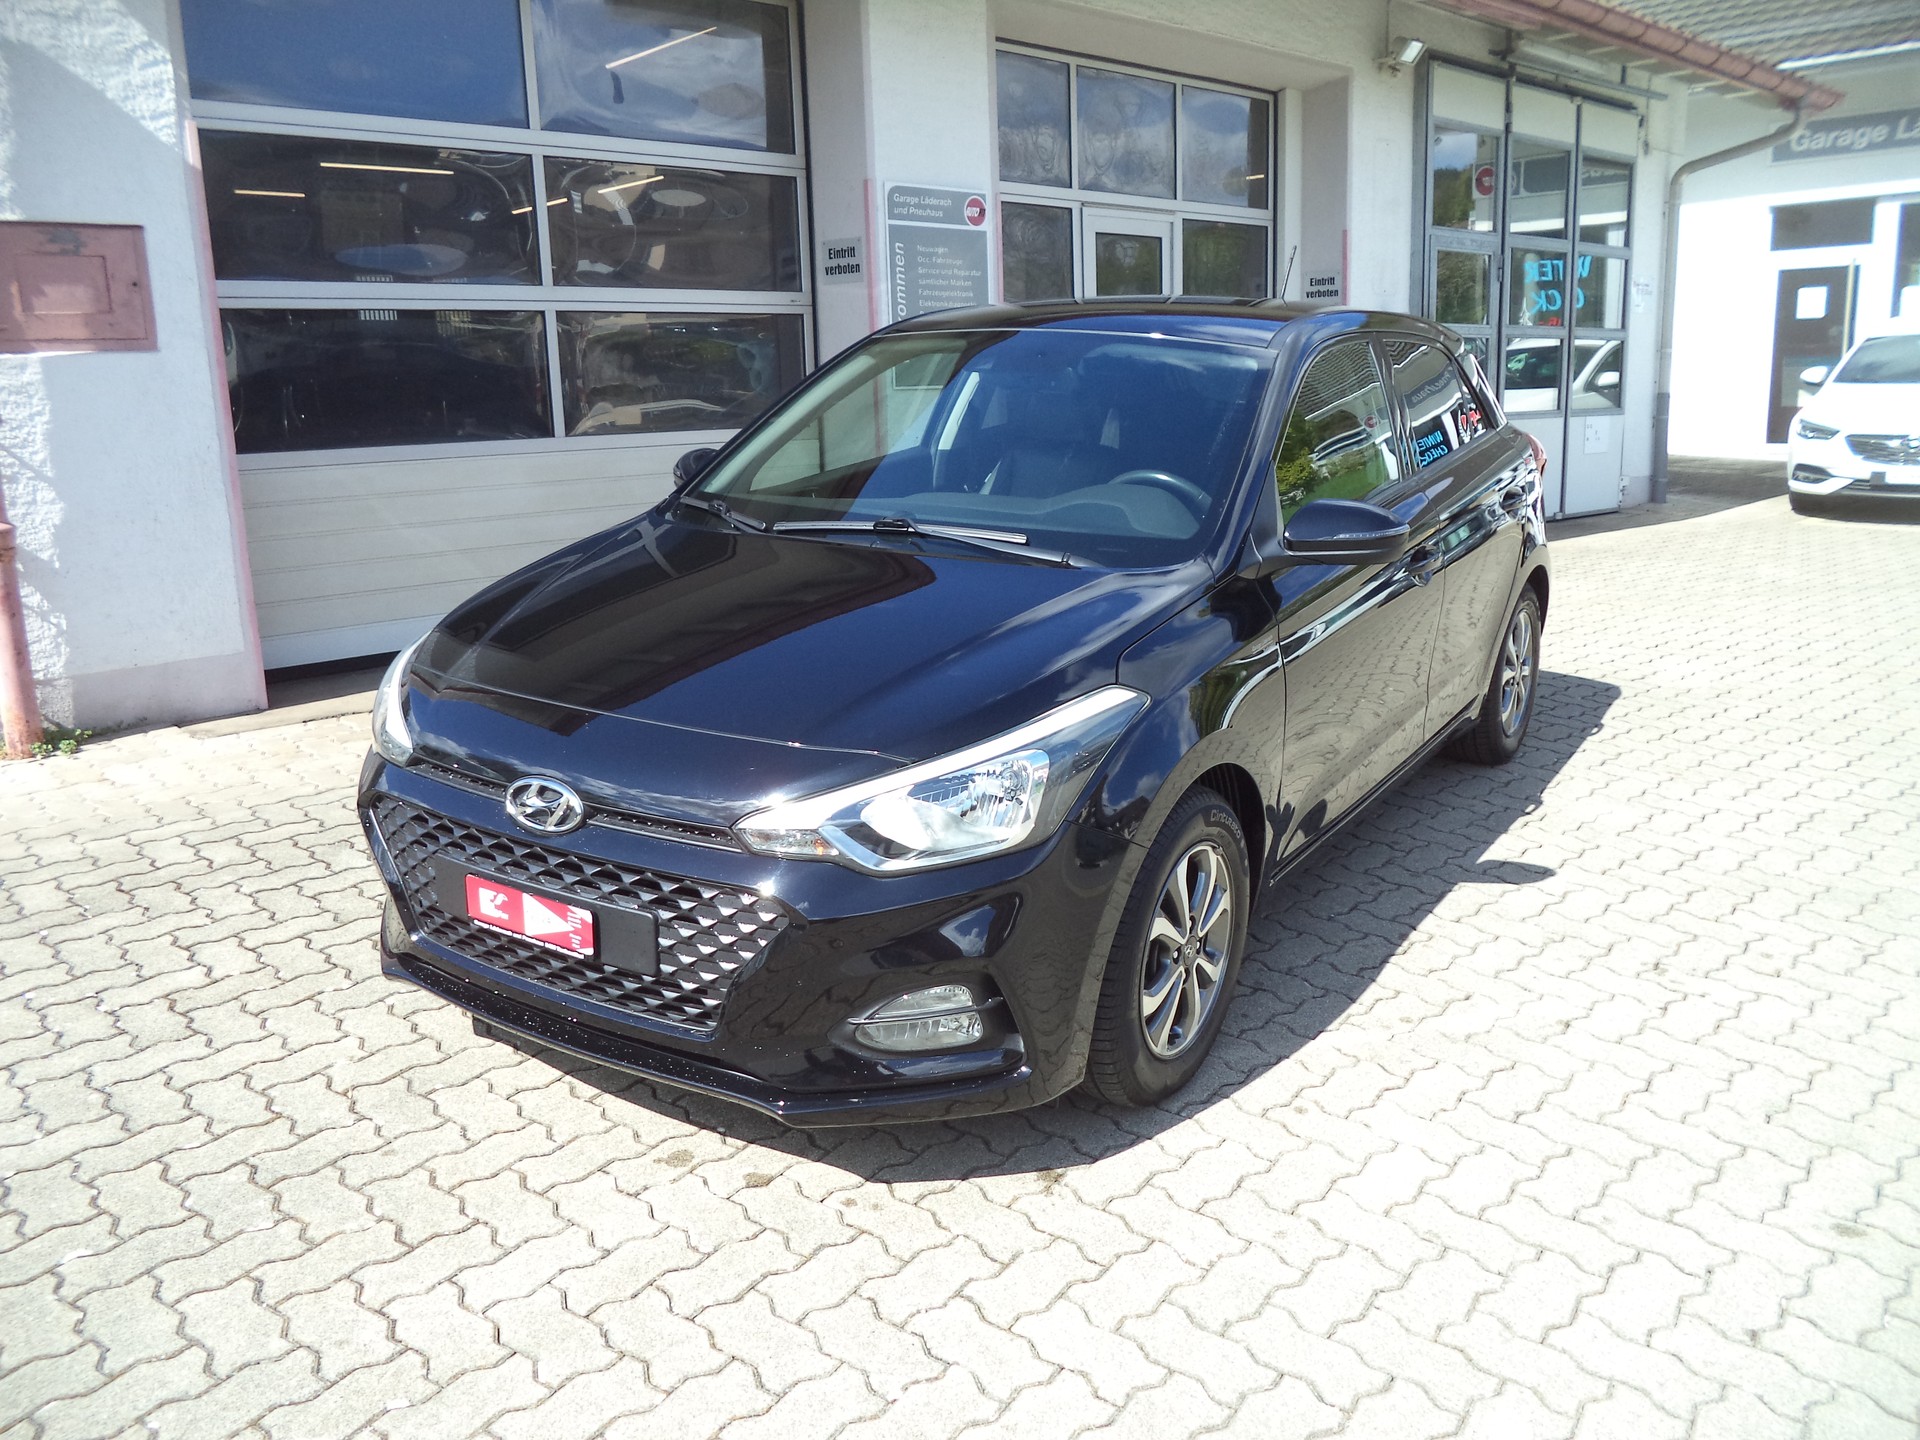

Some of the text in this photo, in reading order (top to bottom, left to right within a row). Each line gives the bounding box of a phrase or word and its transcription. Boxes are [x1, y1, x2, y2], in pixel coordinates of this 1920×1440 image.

[1790, 124, 1890, 152] Garage
[893, 193, 919, 205] Garage
[894, 206, 943, 217] und Pneuhaus
[828, 246, 856, 260] Eintritt
[825, 262, 861, 276] verboten
[1309, 276, 1336, 287] Eintritt
[1305, 289, 1339, 298] verboten
